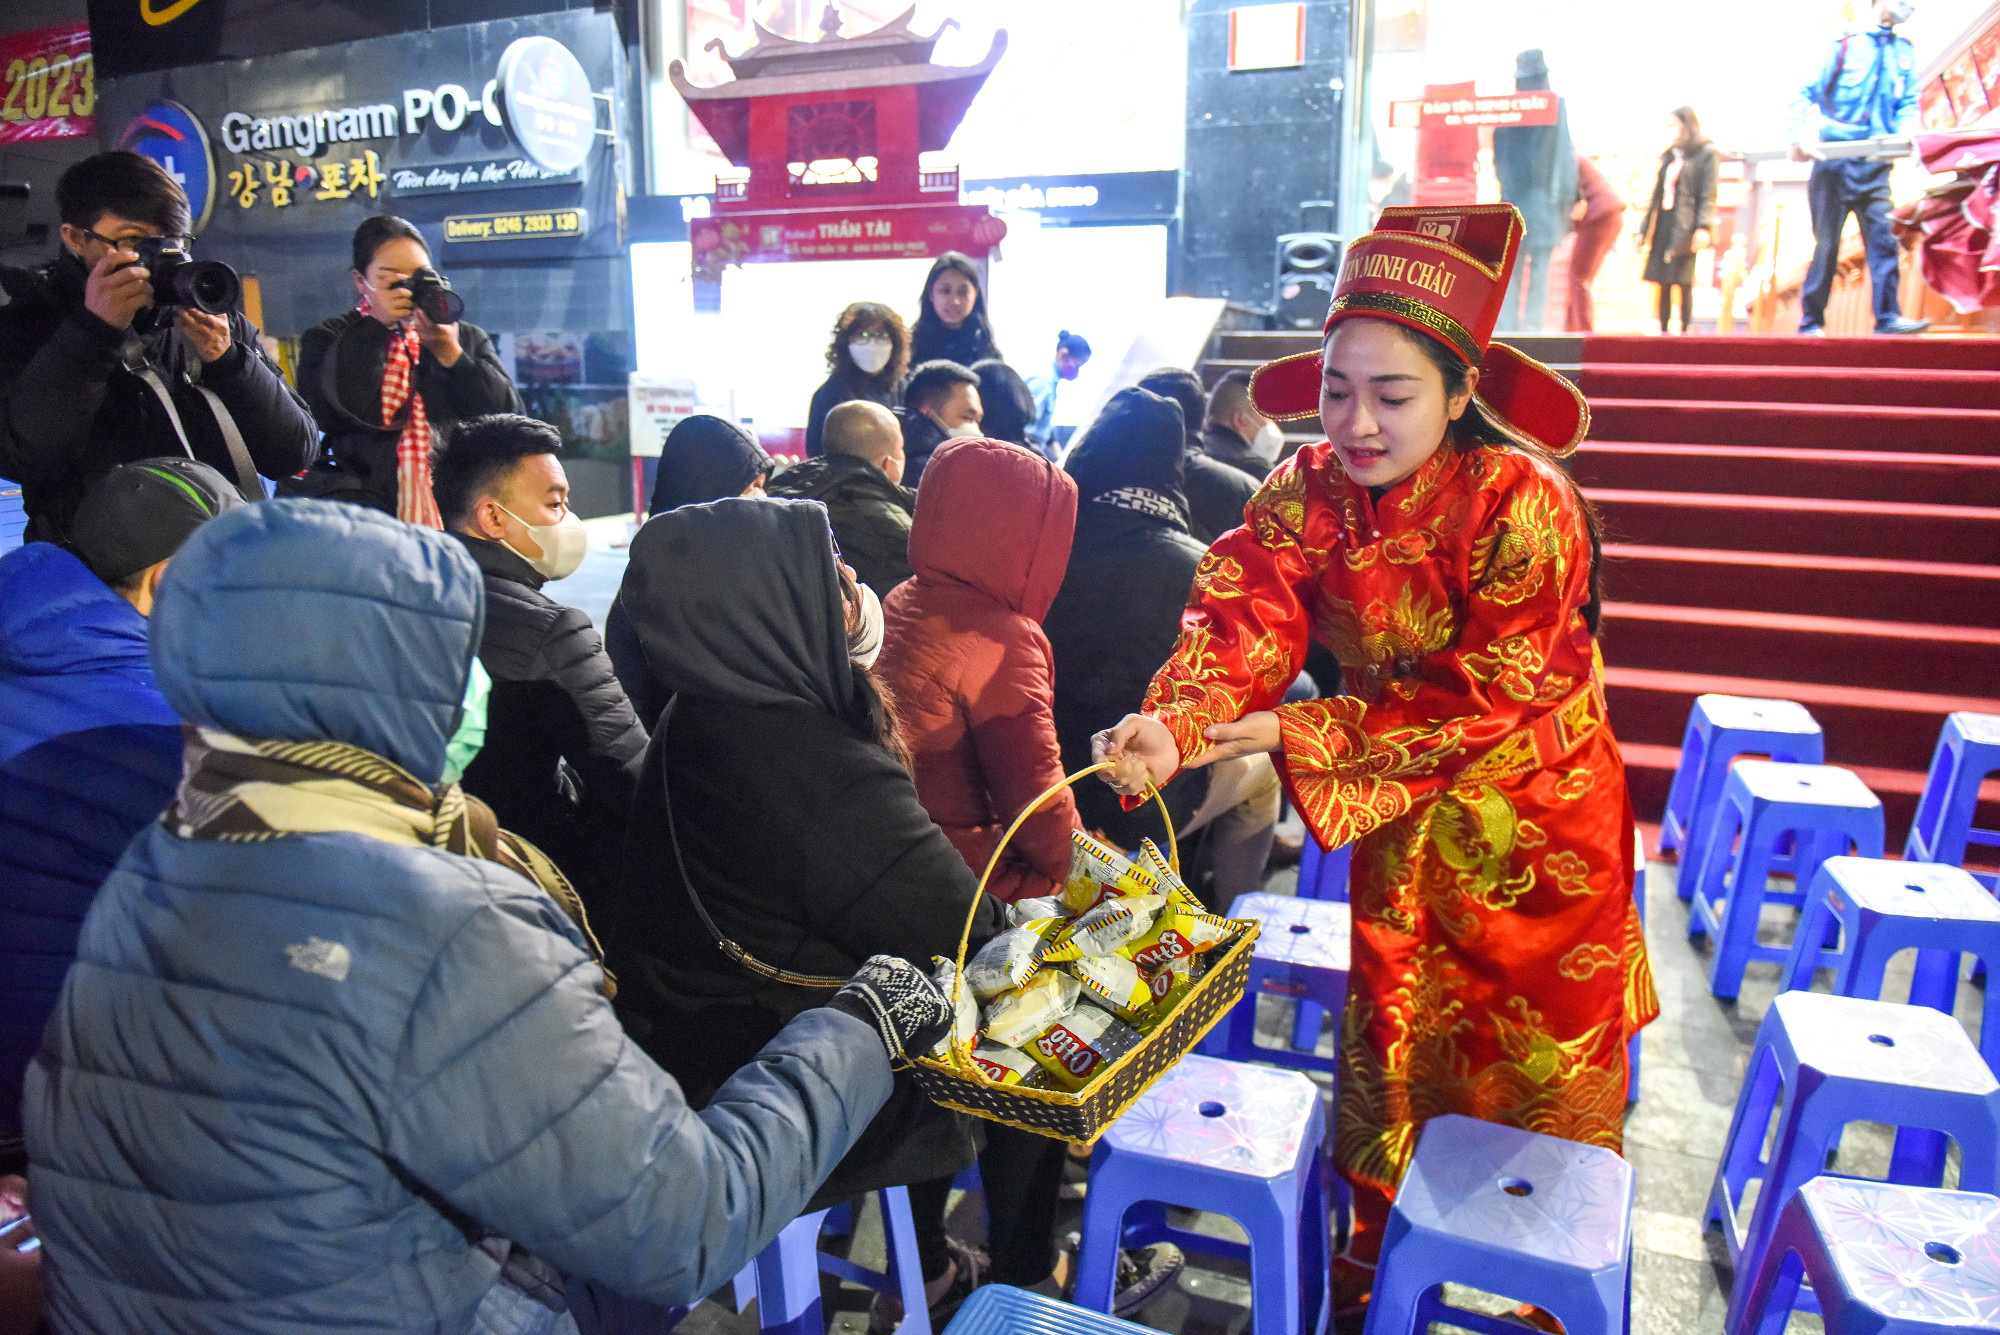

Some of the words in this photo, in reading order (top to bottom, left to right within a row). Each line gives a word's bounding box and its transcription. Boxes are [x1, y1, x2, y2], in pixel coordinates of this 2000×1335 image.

[1, 53, 95, 120] 2023
[221, 104, 399, 157] Gangnam
[228, 159, 296, 209] 강남
[315, 149, 389, 201] 포차
[1359, 253, 1408, 282] MINH
[1406, 260, 1457, 298] CHÂU
